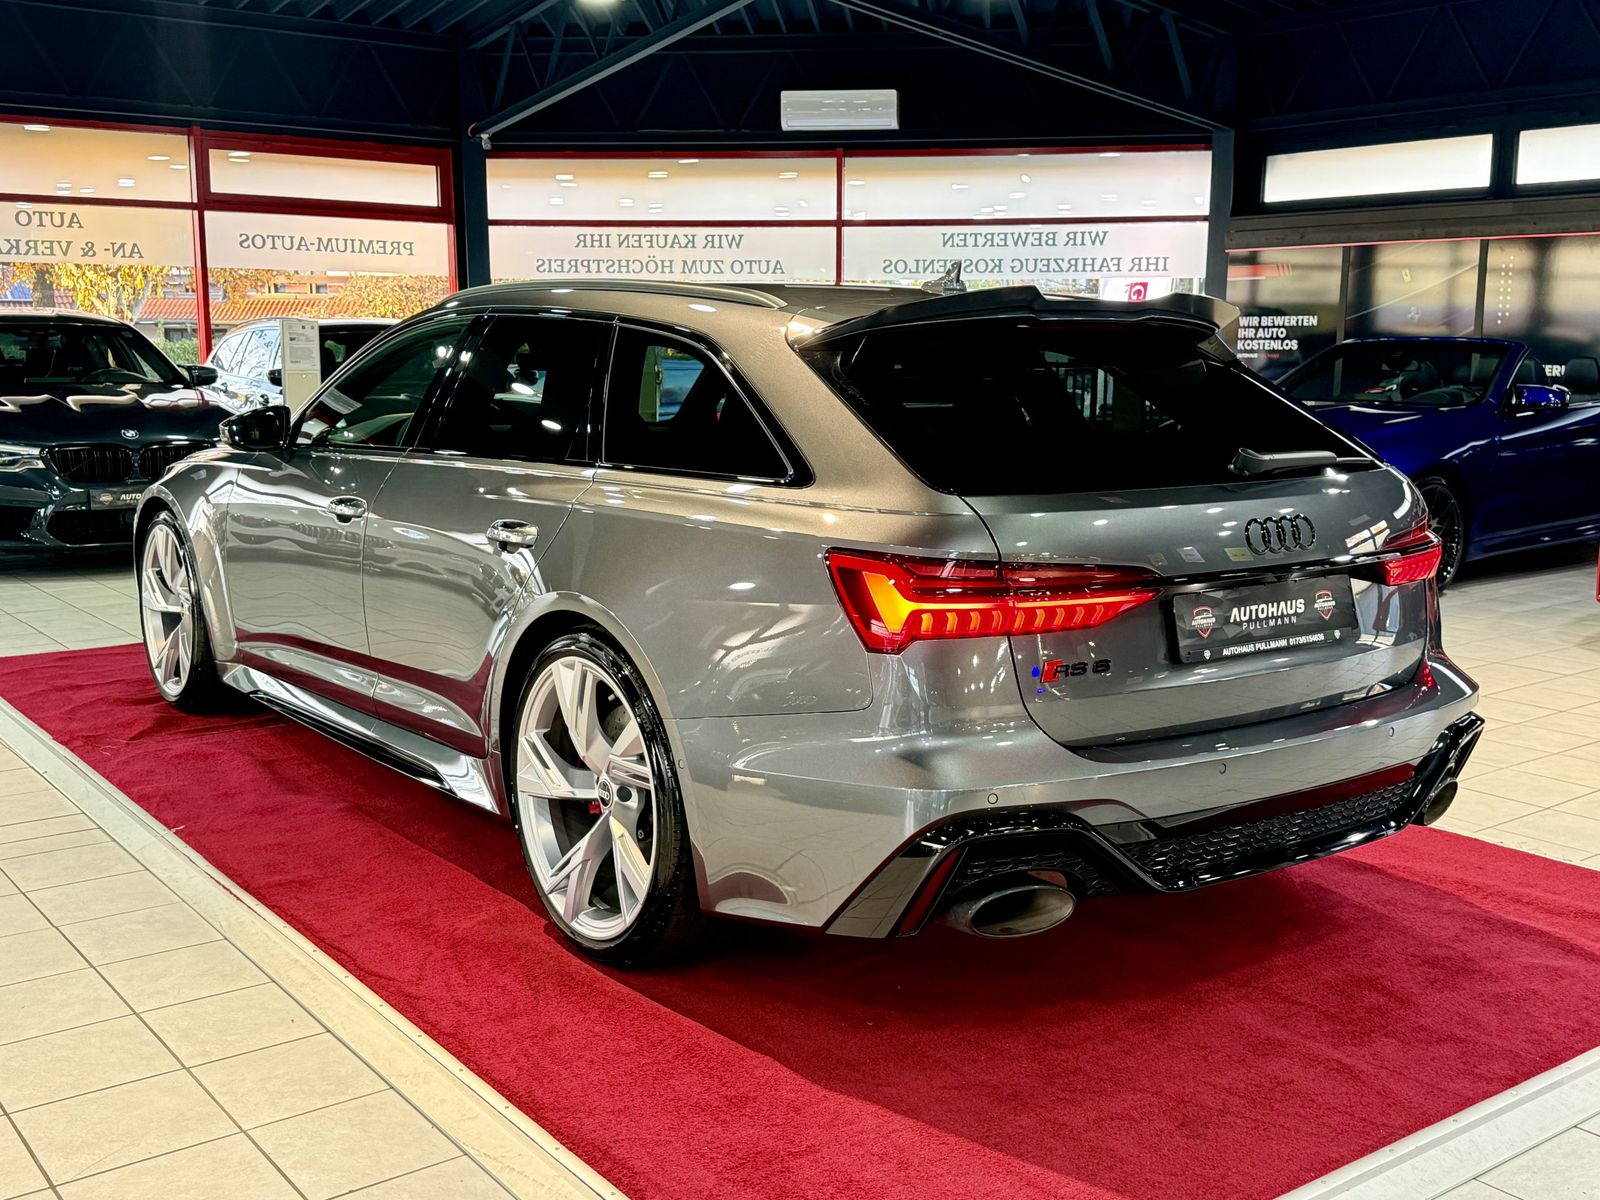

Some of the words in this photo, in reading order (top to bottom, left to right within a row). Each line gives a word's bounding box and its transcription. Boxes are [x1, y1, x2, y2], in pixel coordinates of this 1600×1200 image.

[1239, 316, 1259, 327] WIR
[1260, 315, 1318, 327] BEWERTEN
[1237, 328, 1255, 338] IHR
[1256, 328, 1287, 338] AUTO
[1237, 340, 1298, 350] KOSTENLOS
[1230, 599, 1305, 623] AUTOHAUS
[1242, 615, 1297, 631] PULLMANN
[1222, 644, 1255, 656] AUTOHAUS
[1255, 639, 1288, 651] PULLMANN
[1092, 658, 1111, 674] 6
